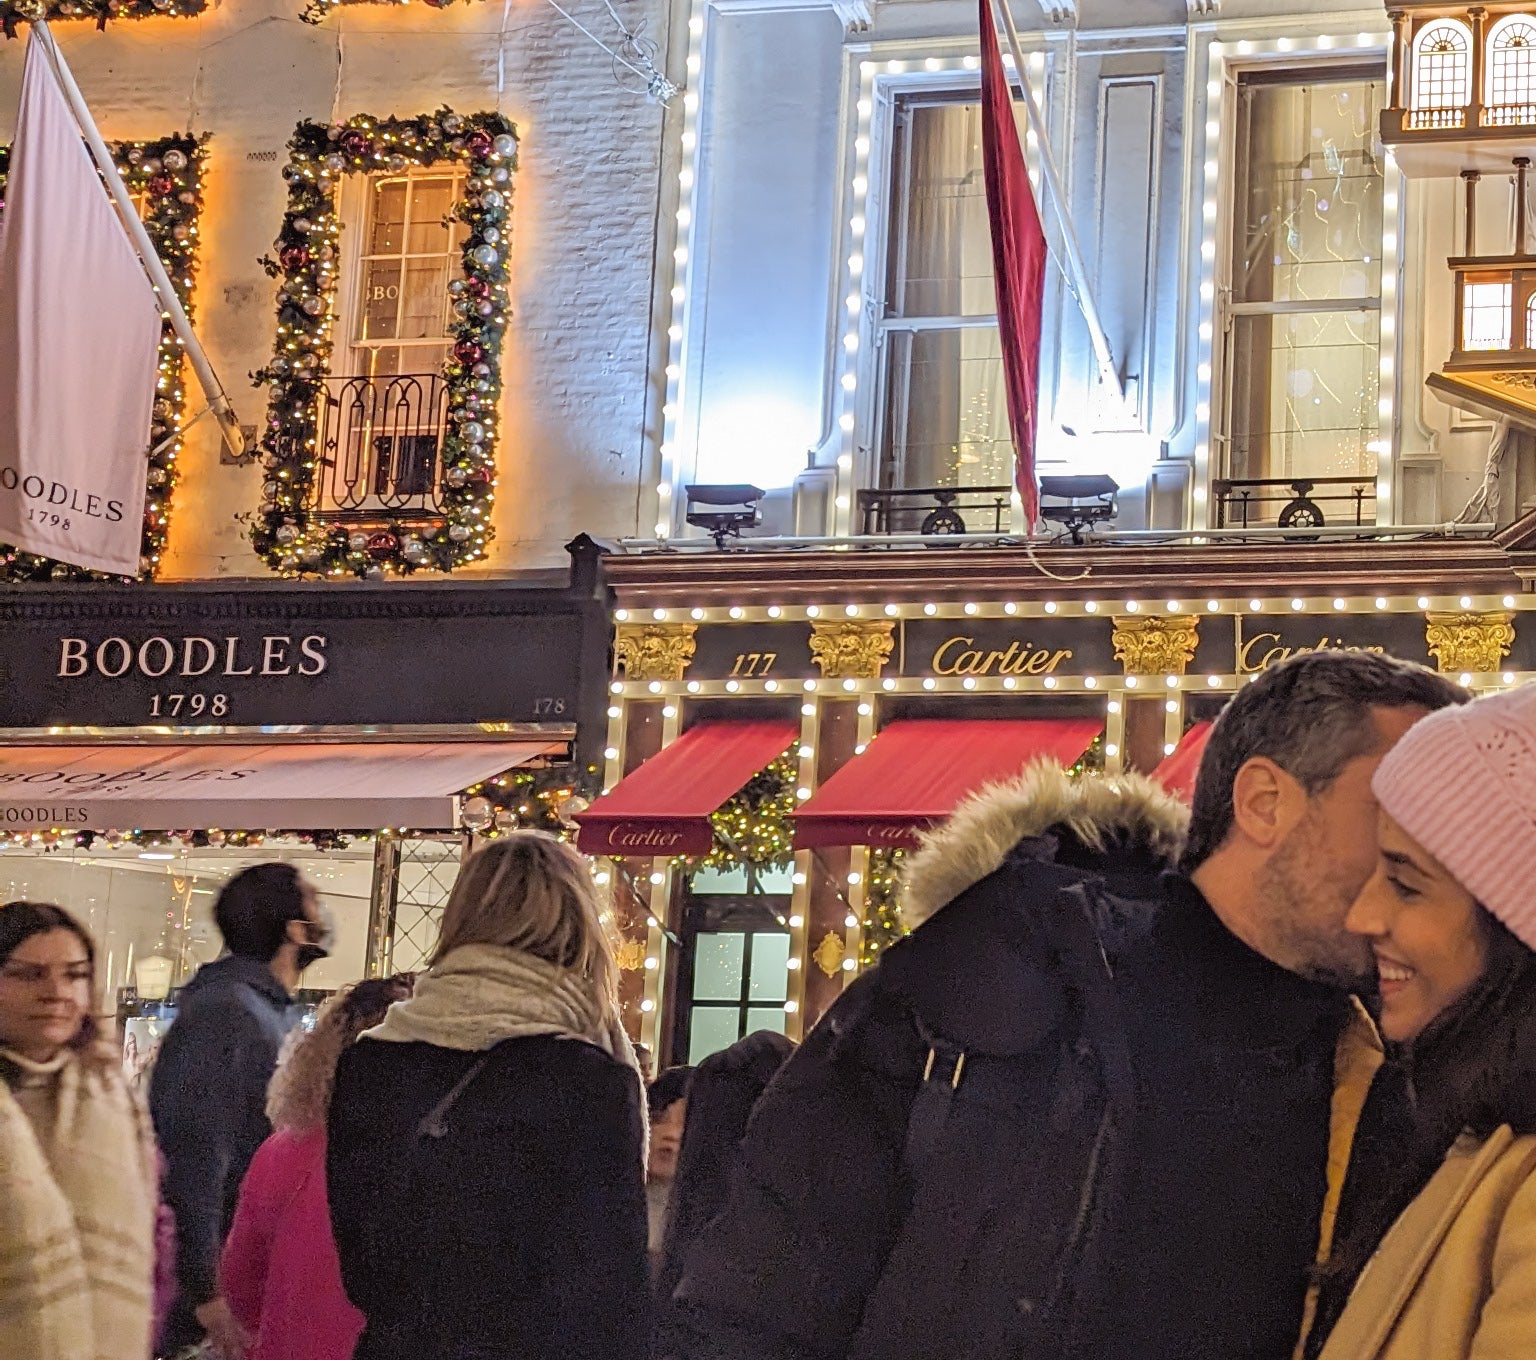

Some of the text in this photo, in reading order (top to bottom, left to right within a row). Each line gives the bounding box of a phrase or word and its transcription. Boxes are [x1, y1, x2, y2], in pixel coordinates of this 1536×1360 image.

[28, 508, 71, 531] 1798
[57, 635, 328, 677] BOODLES
[729, 653, 777, 678] 177
[932, 636, 1073, 676] Cartier
[149, 694, 228, 717] 1798
[534, 697, 567, 715] 178
[608, 822, 683, 848] Cartier
